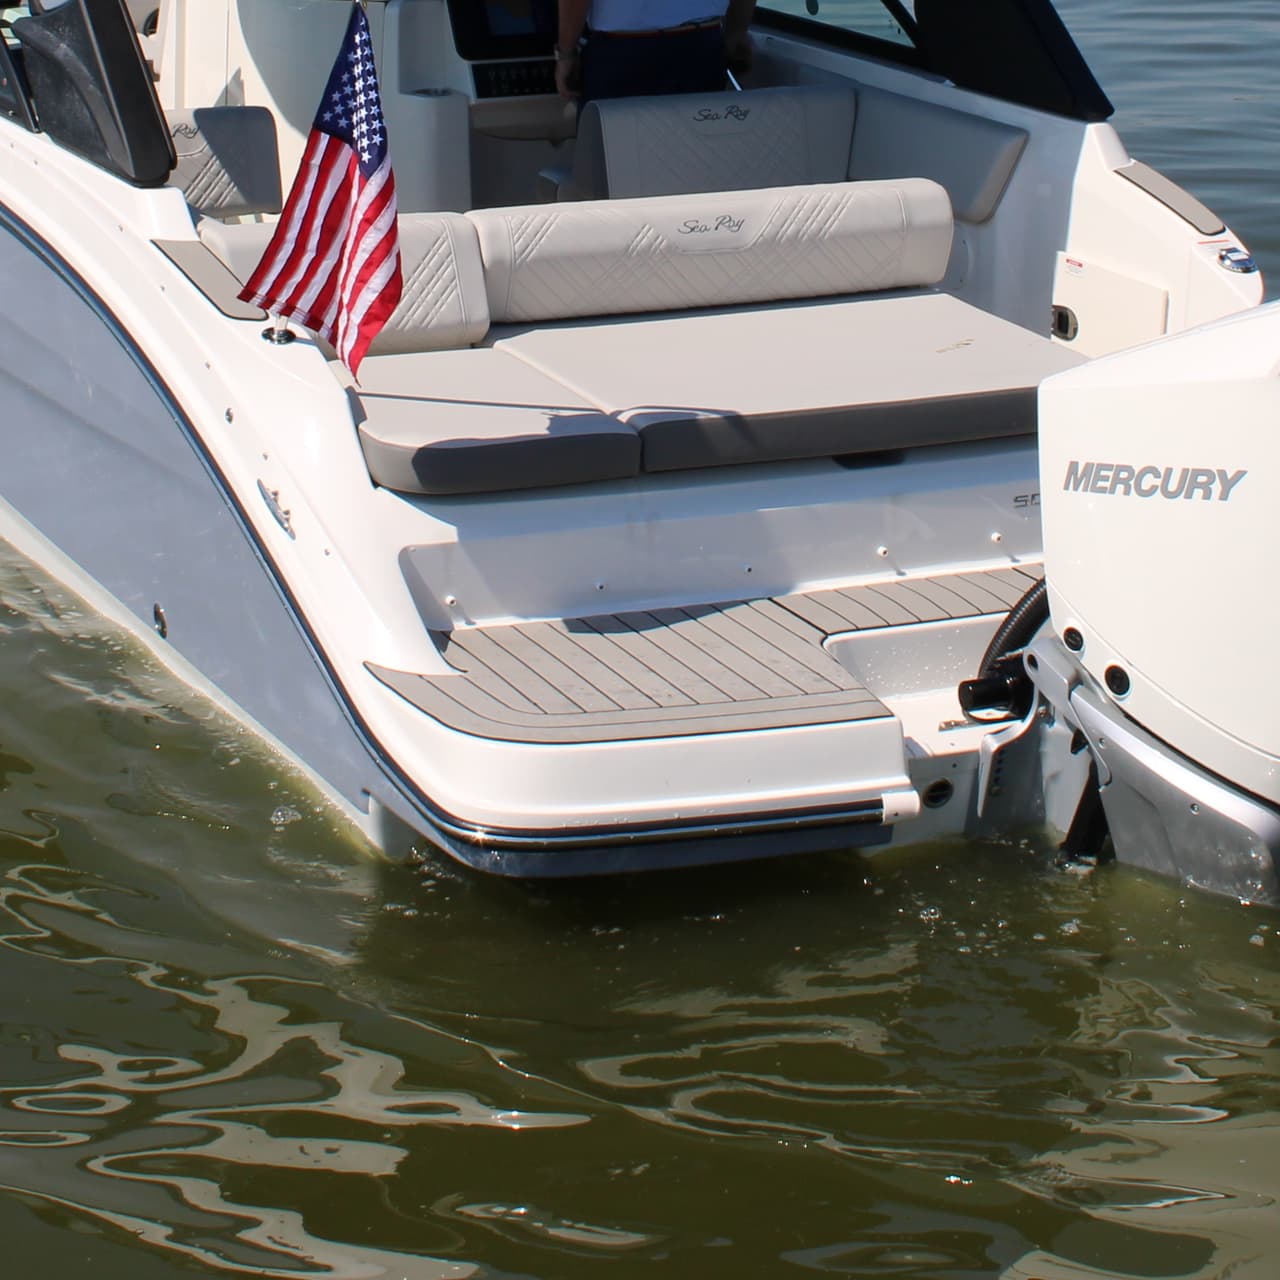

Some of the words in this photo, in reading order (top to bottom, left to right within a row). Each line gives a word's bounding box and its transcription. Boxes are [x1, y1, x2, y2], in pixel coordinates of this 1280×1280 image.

[693, 108, 720, 121] Sea
[724, 104, 751, 121] Ray
[678, 219, 712, 235] Sea
[714, 214, 745, 233] Ray
[1063, 460, 1248, 502] MERCURY
